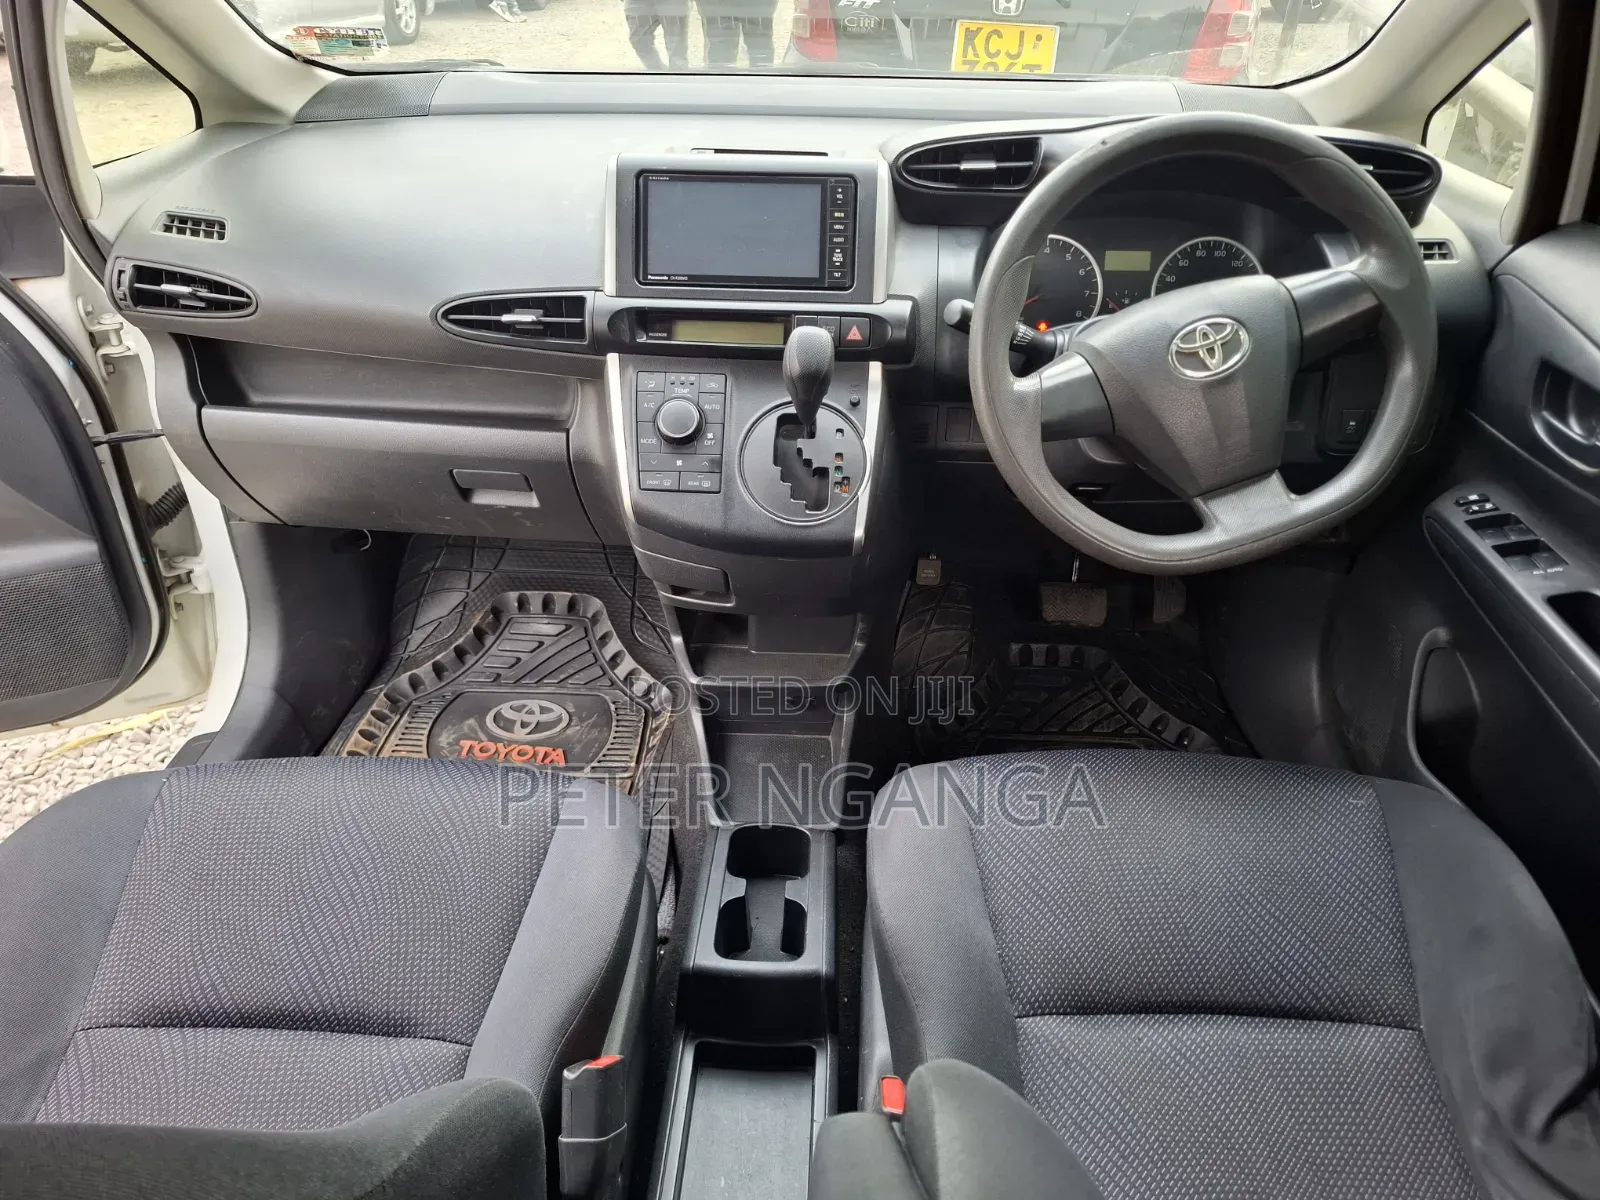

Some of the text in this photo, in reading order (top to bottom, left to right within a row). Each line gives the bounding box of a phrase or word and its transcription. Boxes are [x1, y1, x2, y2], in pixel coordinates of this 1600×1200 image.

[844, 16, 875, 27] Citi
[962, 27, 1025, 59] KCJ
[1065, 253, 1072, 261] 5
[1076, 310, 1082, 318] 8
[459, 740, 567, 767] TOYOTA
